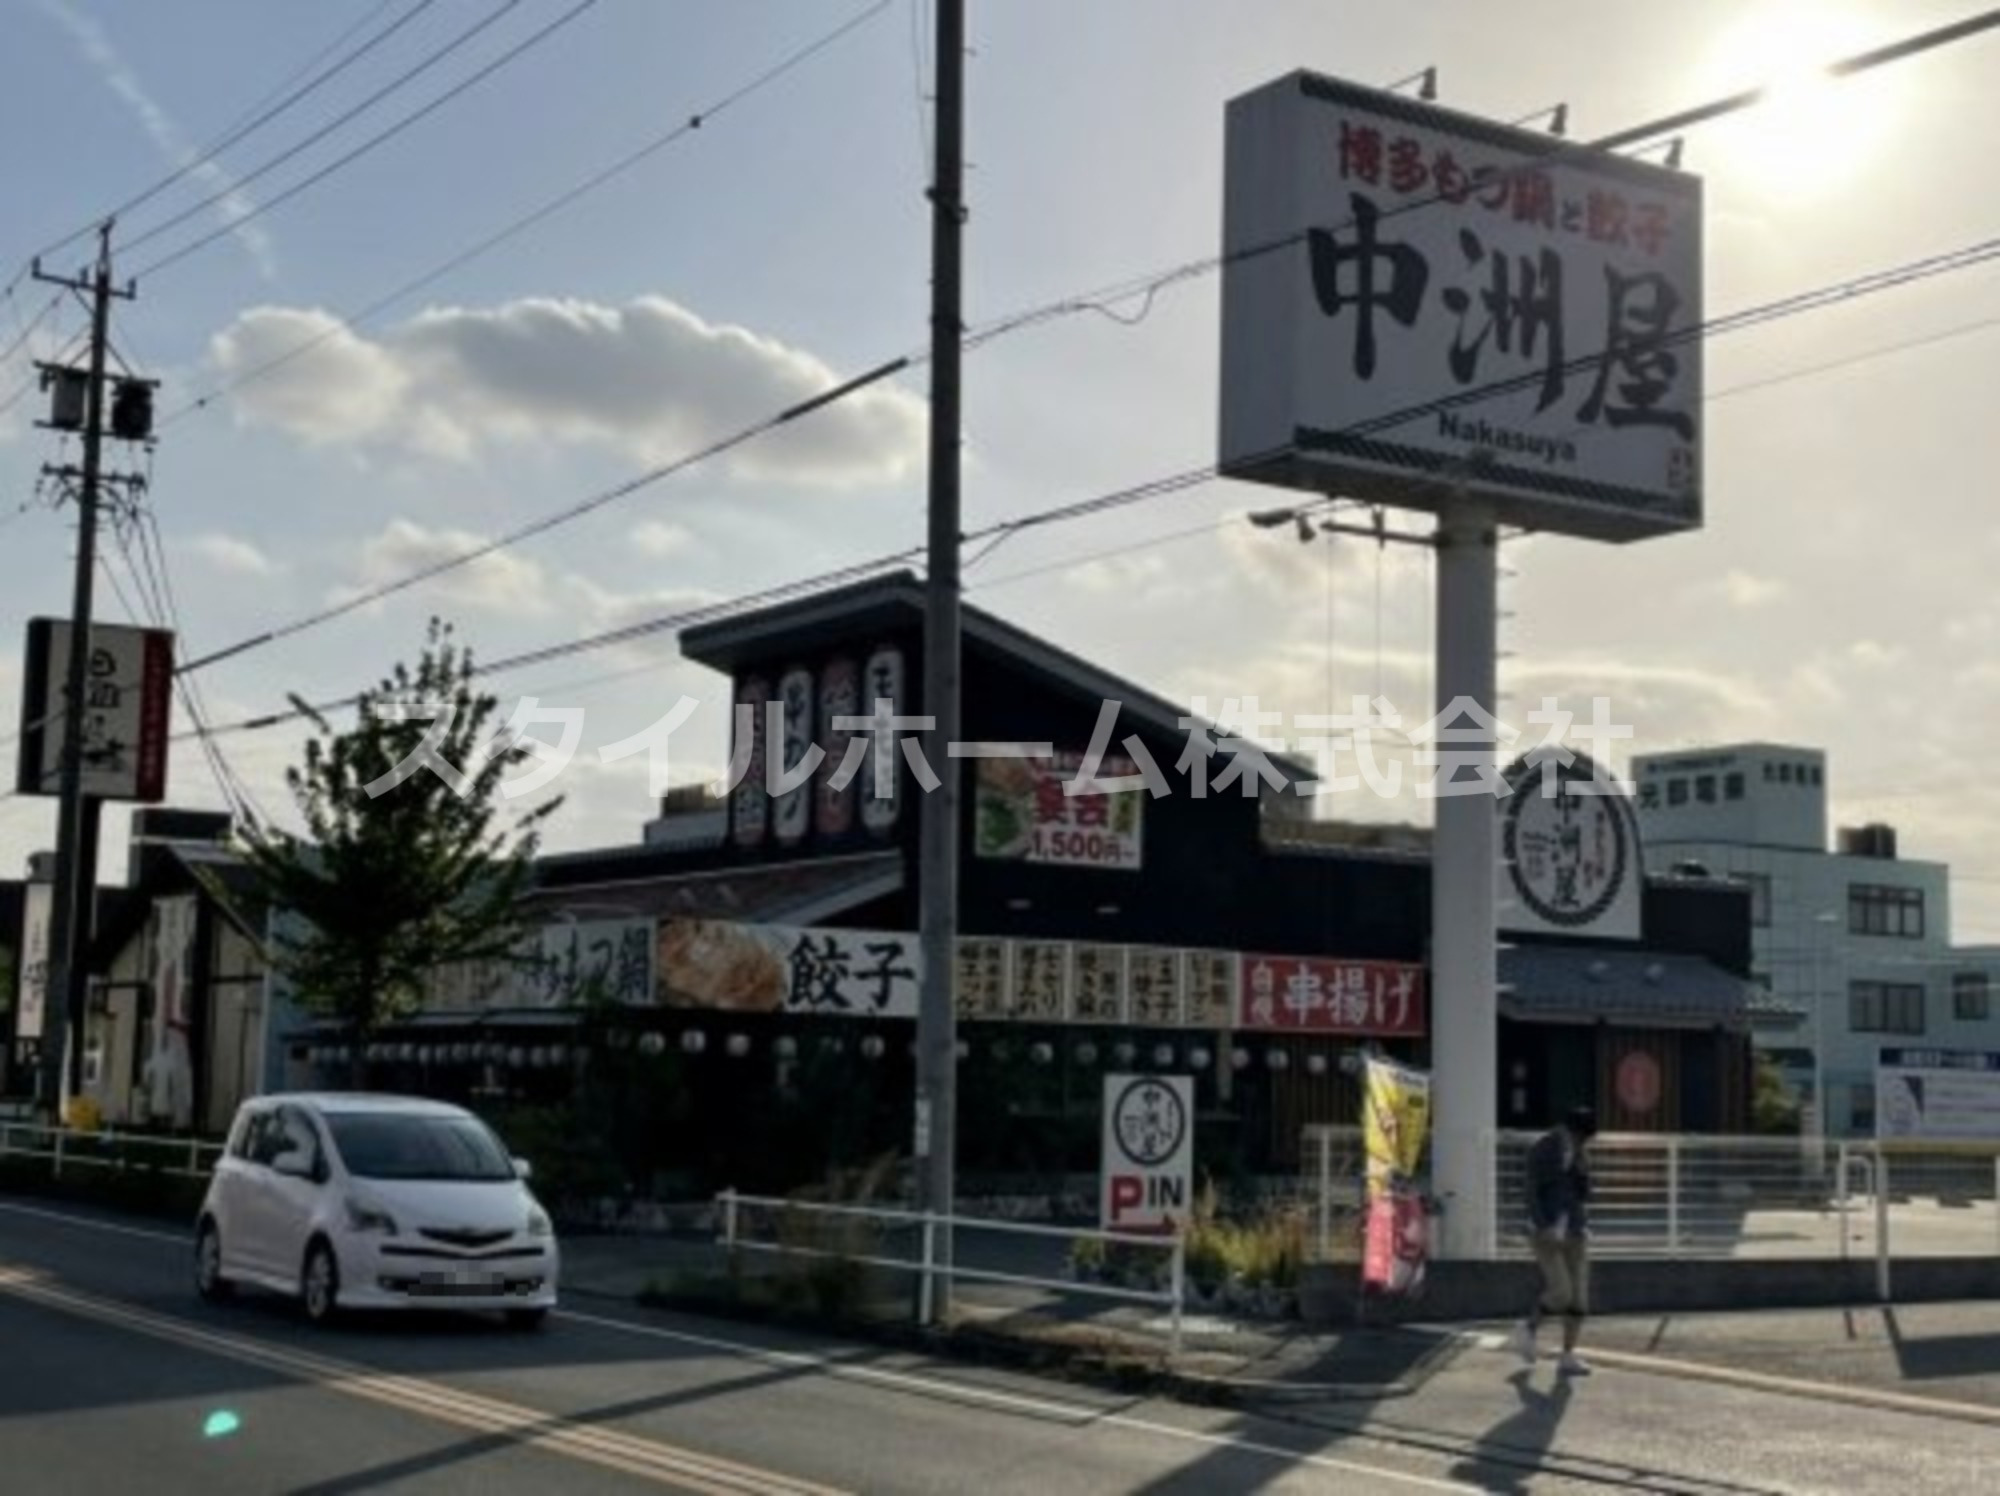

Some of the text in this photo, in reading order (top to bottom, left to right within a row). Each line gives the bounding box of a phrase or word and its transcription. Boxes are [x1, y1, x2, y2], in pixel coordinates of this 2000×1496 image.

[1338, 119, 1672, 255] 博多もつ鍋と餃子
[1306, 191, 1696, 441] 中洲屋
[1438, 411, 1577, 462] Nakasuya
[786, 935, 916, 1009] 餃子
[1282, 961, 1416, 1028] 串揚げ
[1110, 1175, 1183, 1221] P IN
